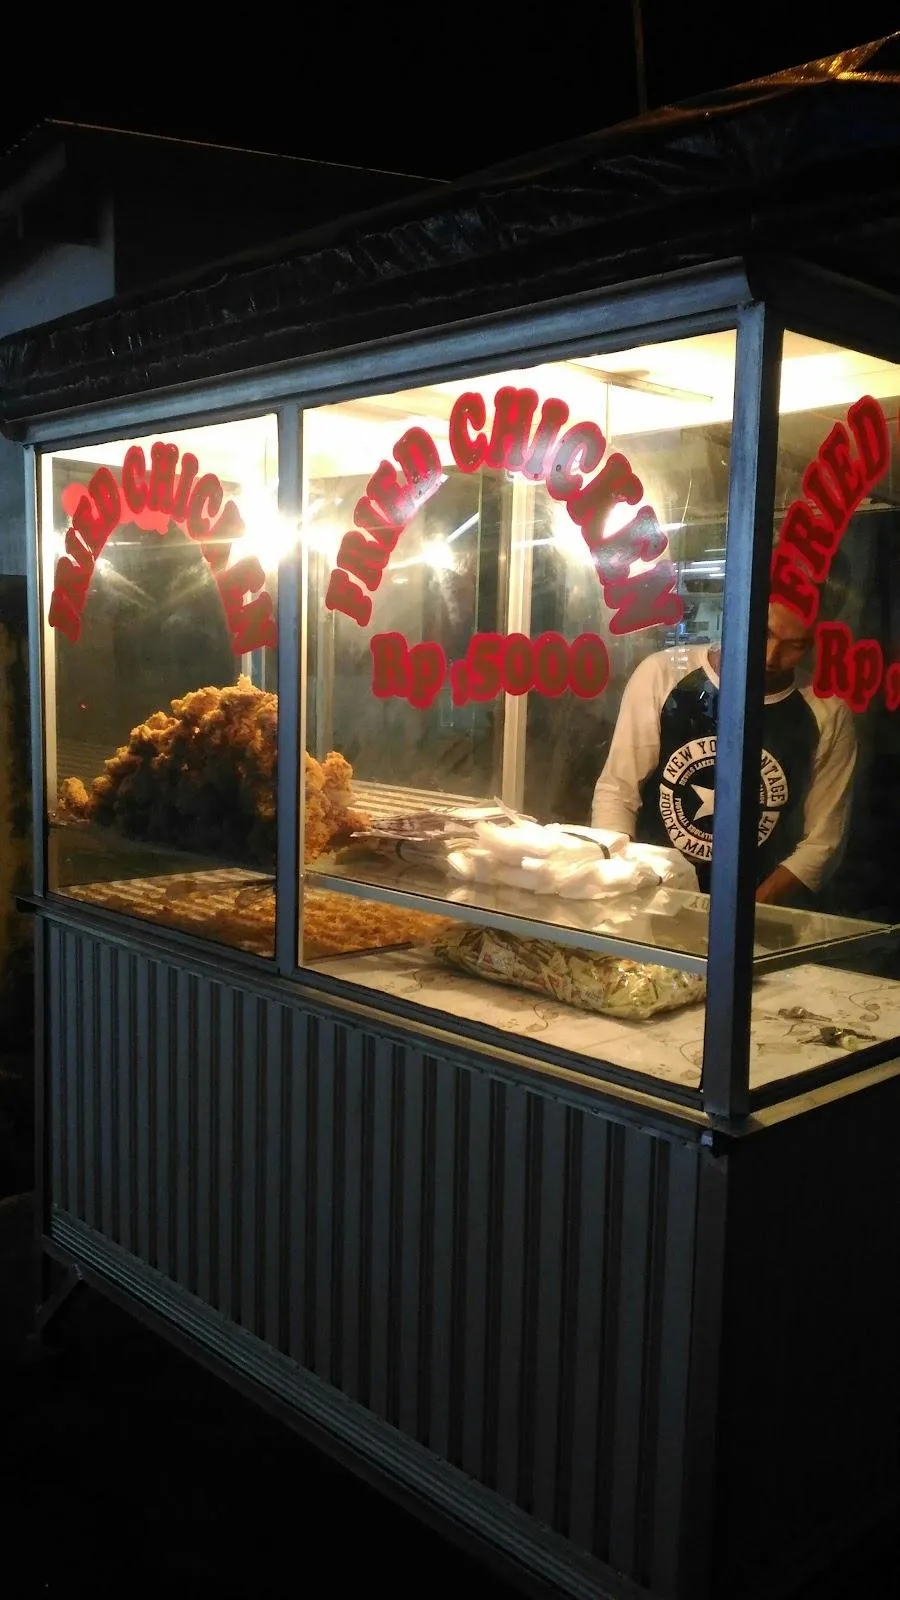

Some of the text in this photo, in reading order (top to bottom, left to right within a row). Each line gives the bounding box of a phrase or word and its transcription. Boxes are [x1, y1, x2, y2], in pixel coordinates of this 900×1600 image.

[48, 441, 278, 656] FRIED CHICKEN
[325, 385, 684, 636] FRIED CHICKEN
[768, 394, 891, 627] FRIED
[666, 745, 693, 778] NEW
[698, 739, 717, 755] YO
[760, 754, 785, 803] NTAGE
